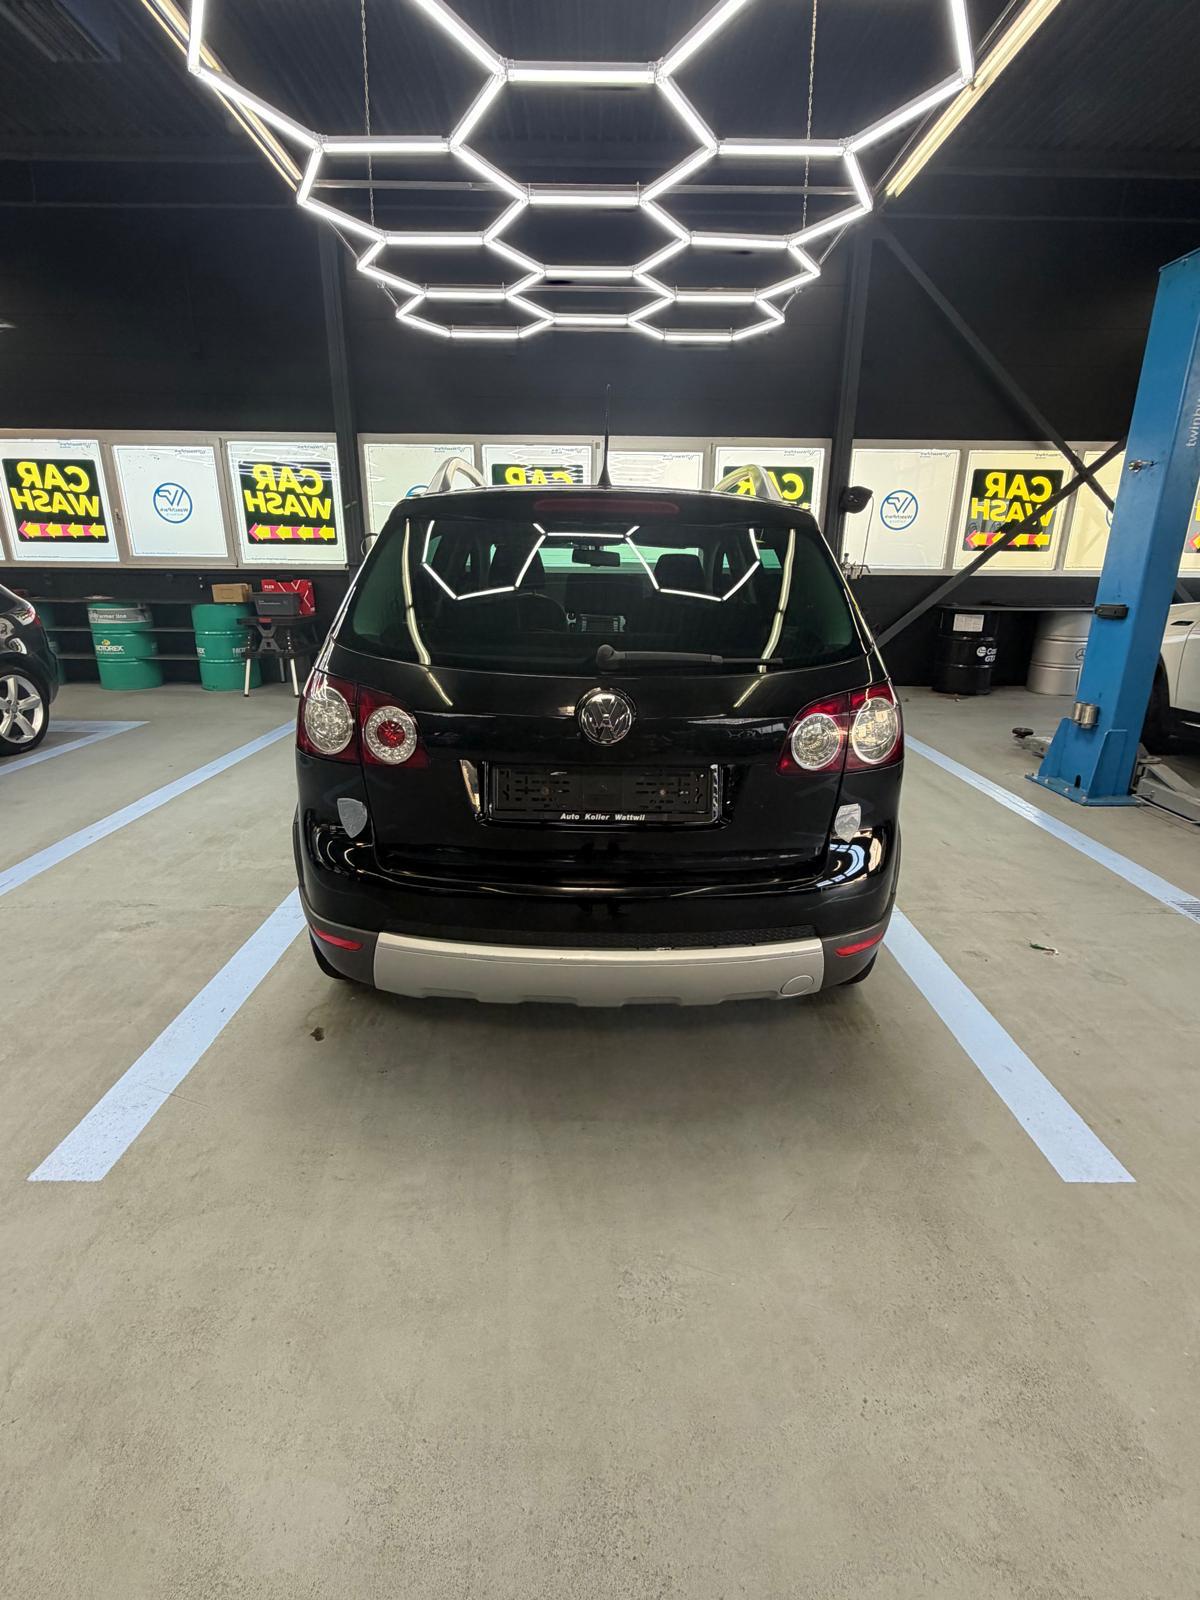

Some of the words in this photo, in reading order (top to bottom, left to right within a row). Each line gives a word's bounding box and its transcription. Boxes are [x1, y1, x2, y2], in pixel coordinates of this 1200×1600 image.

[1185, 397, 1200, 447] twinb
[560, 812, 580, 820] Auto
[584, 813, 610, 821] Koller
[614, 813, 646, 821] Wattwil
